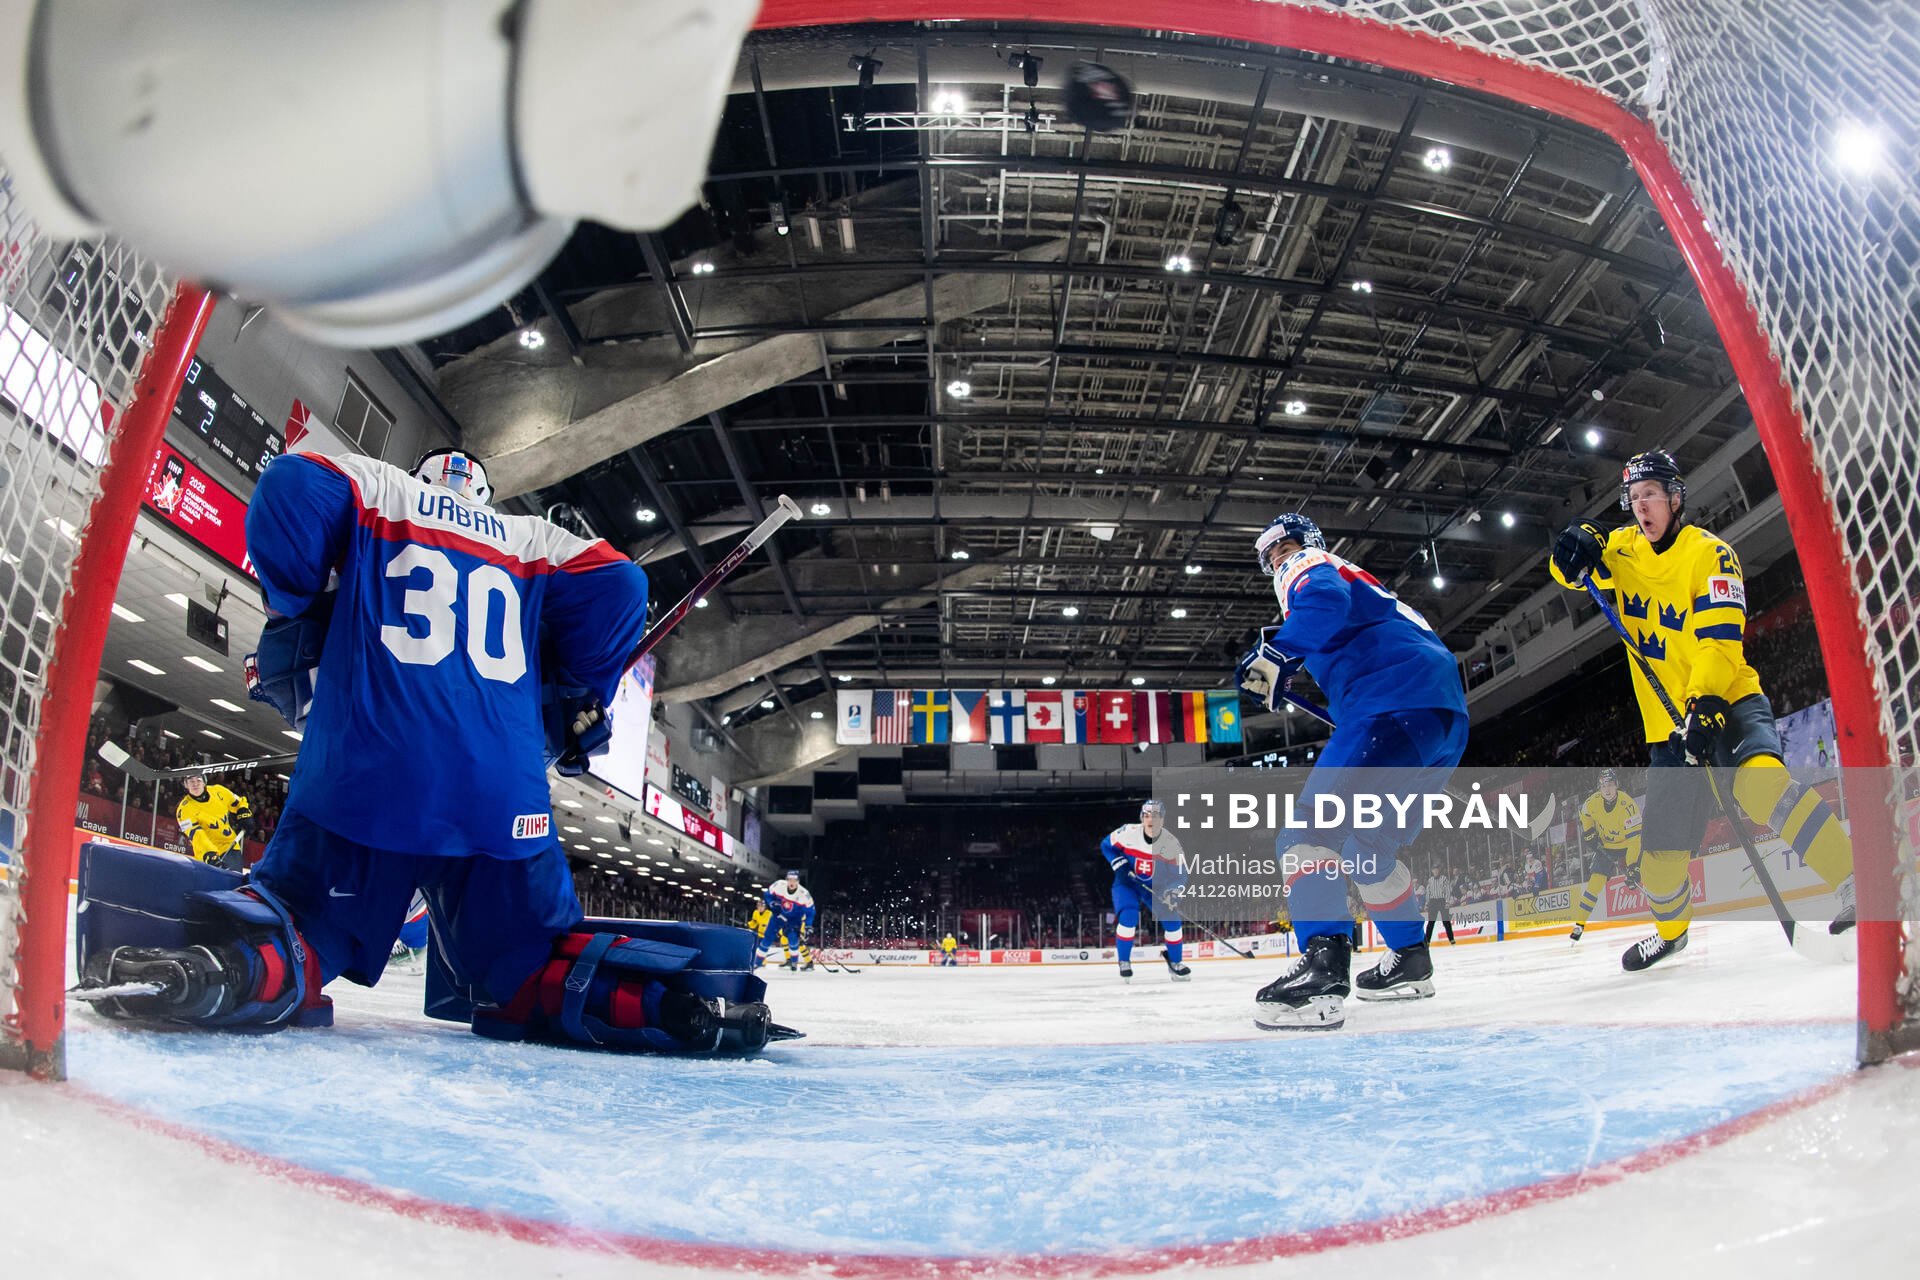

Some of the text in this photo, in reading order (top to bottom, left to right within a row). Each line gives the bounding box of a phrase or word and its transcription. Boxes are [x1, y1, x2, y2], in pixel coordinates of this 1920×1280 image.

[167, 459, 183, 476] IIHF
[189, 475, 207, 495] 2025
[418, 491, 507, 542] URBAN
[380, 543, 527, 684] 30
[526, 816, 547, 836] IIHF
[1514, 893, 1568, 916] OK PNEUS
[1609, 881, 1638, 913] Tim
[1456, 910, 1491, 927] Myers.ca
